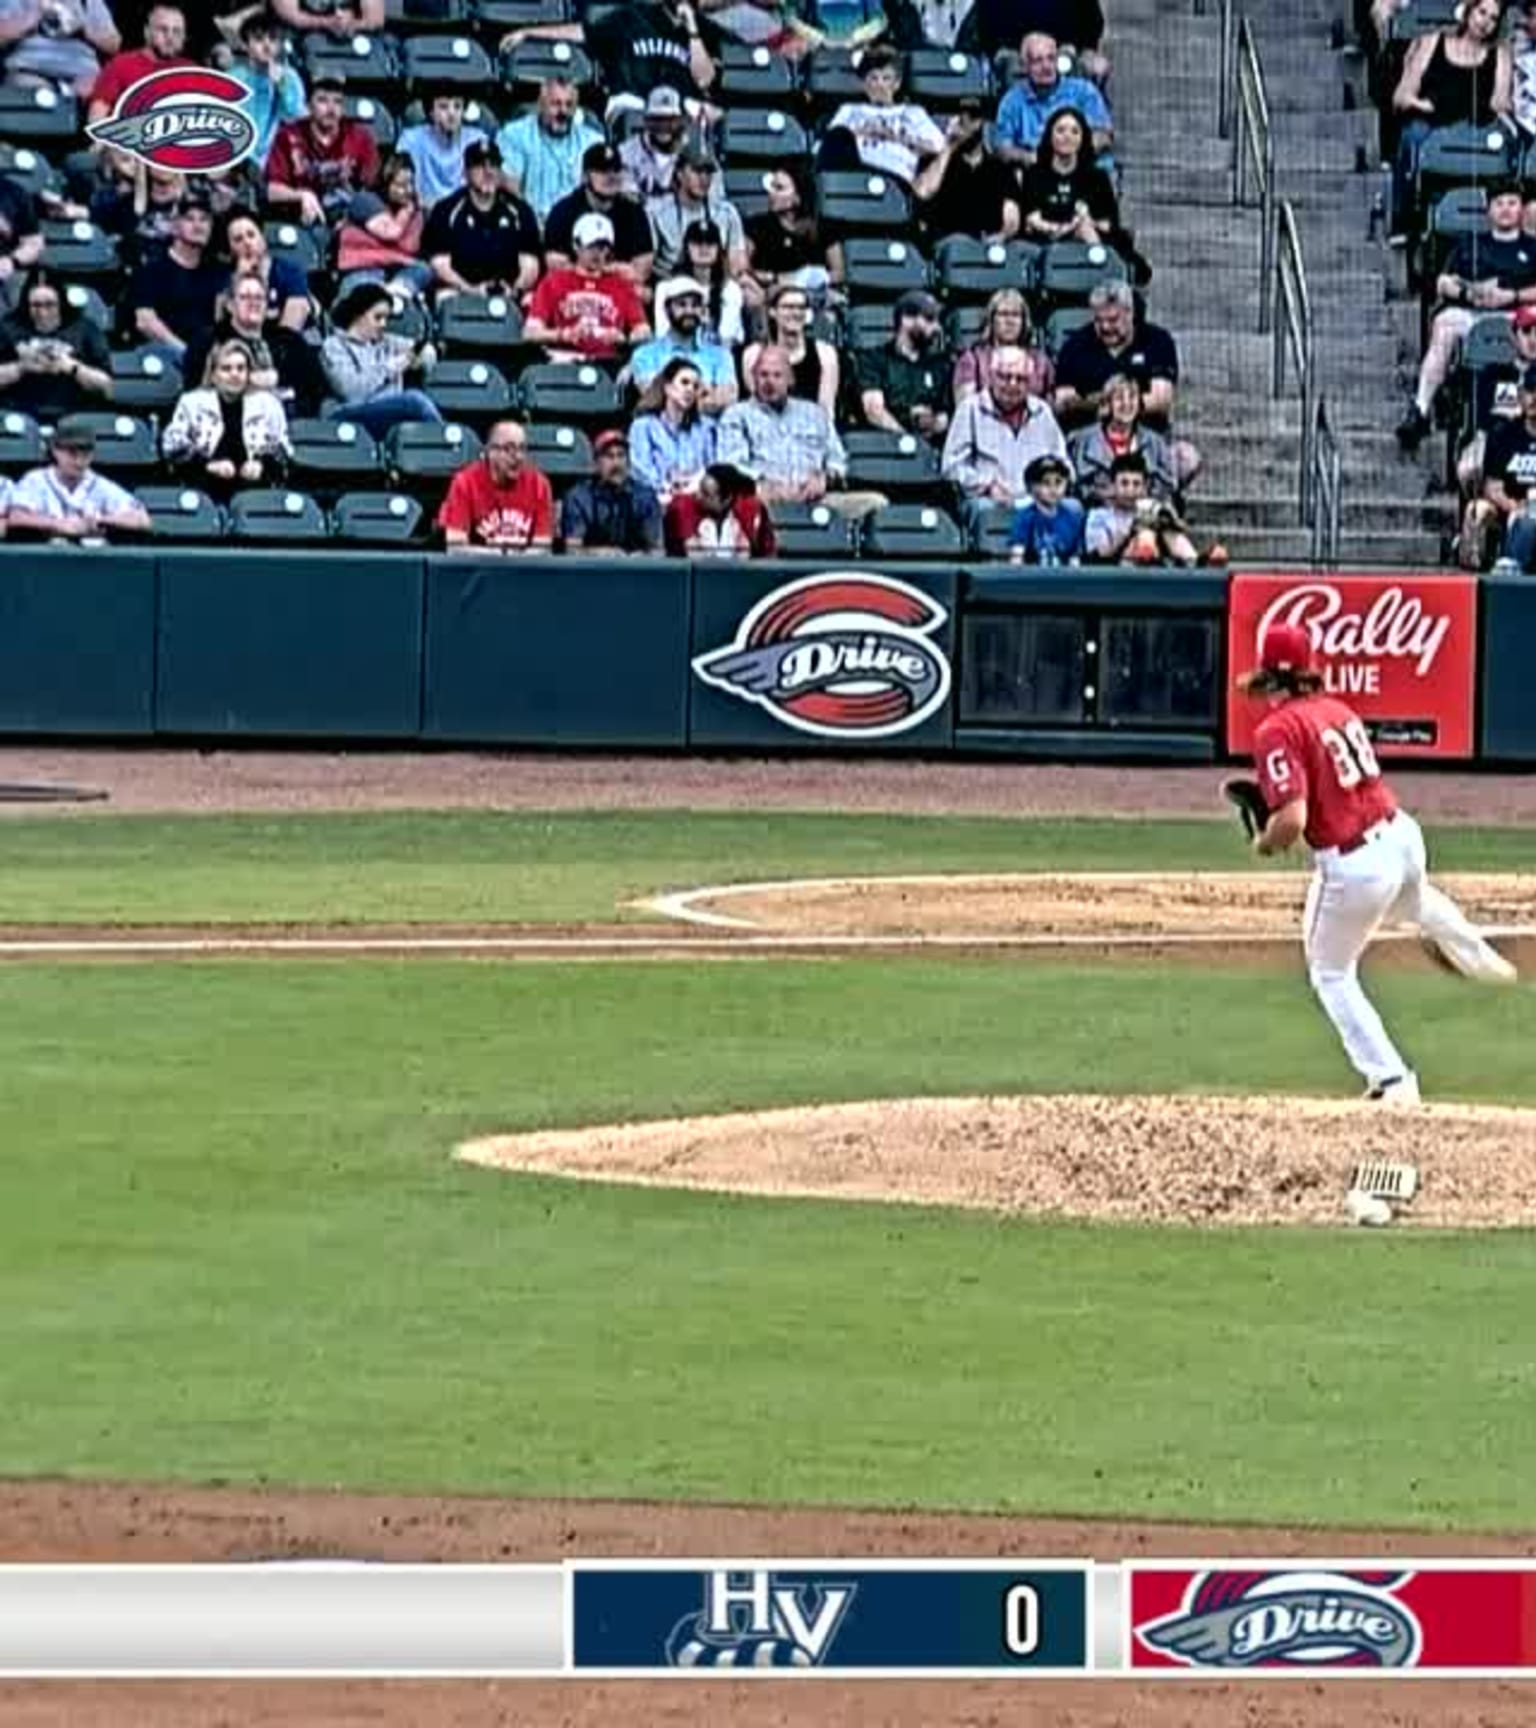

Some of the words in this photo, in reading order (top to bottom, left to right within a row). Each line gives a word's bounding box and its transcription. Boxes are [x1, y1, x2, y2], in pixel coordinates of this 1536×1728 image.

[1257, 584, 1449, 676] Bally
[781, 635, 928, 689] Drive
[1324, 664, 1380, 694] LIVE
[1266, 749, 1290, 783] G
[1321, 717, 1381, 787] 38
